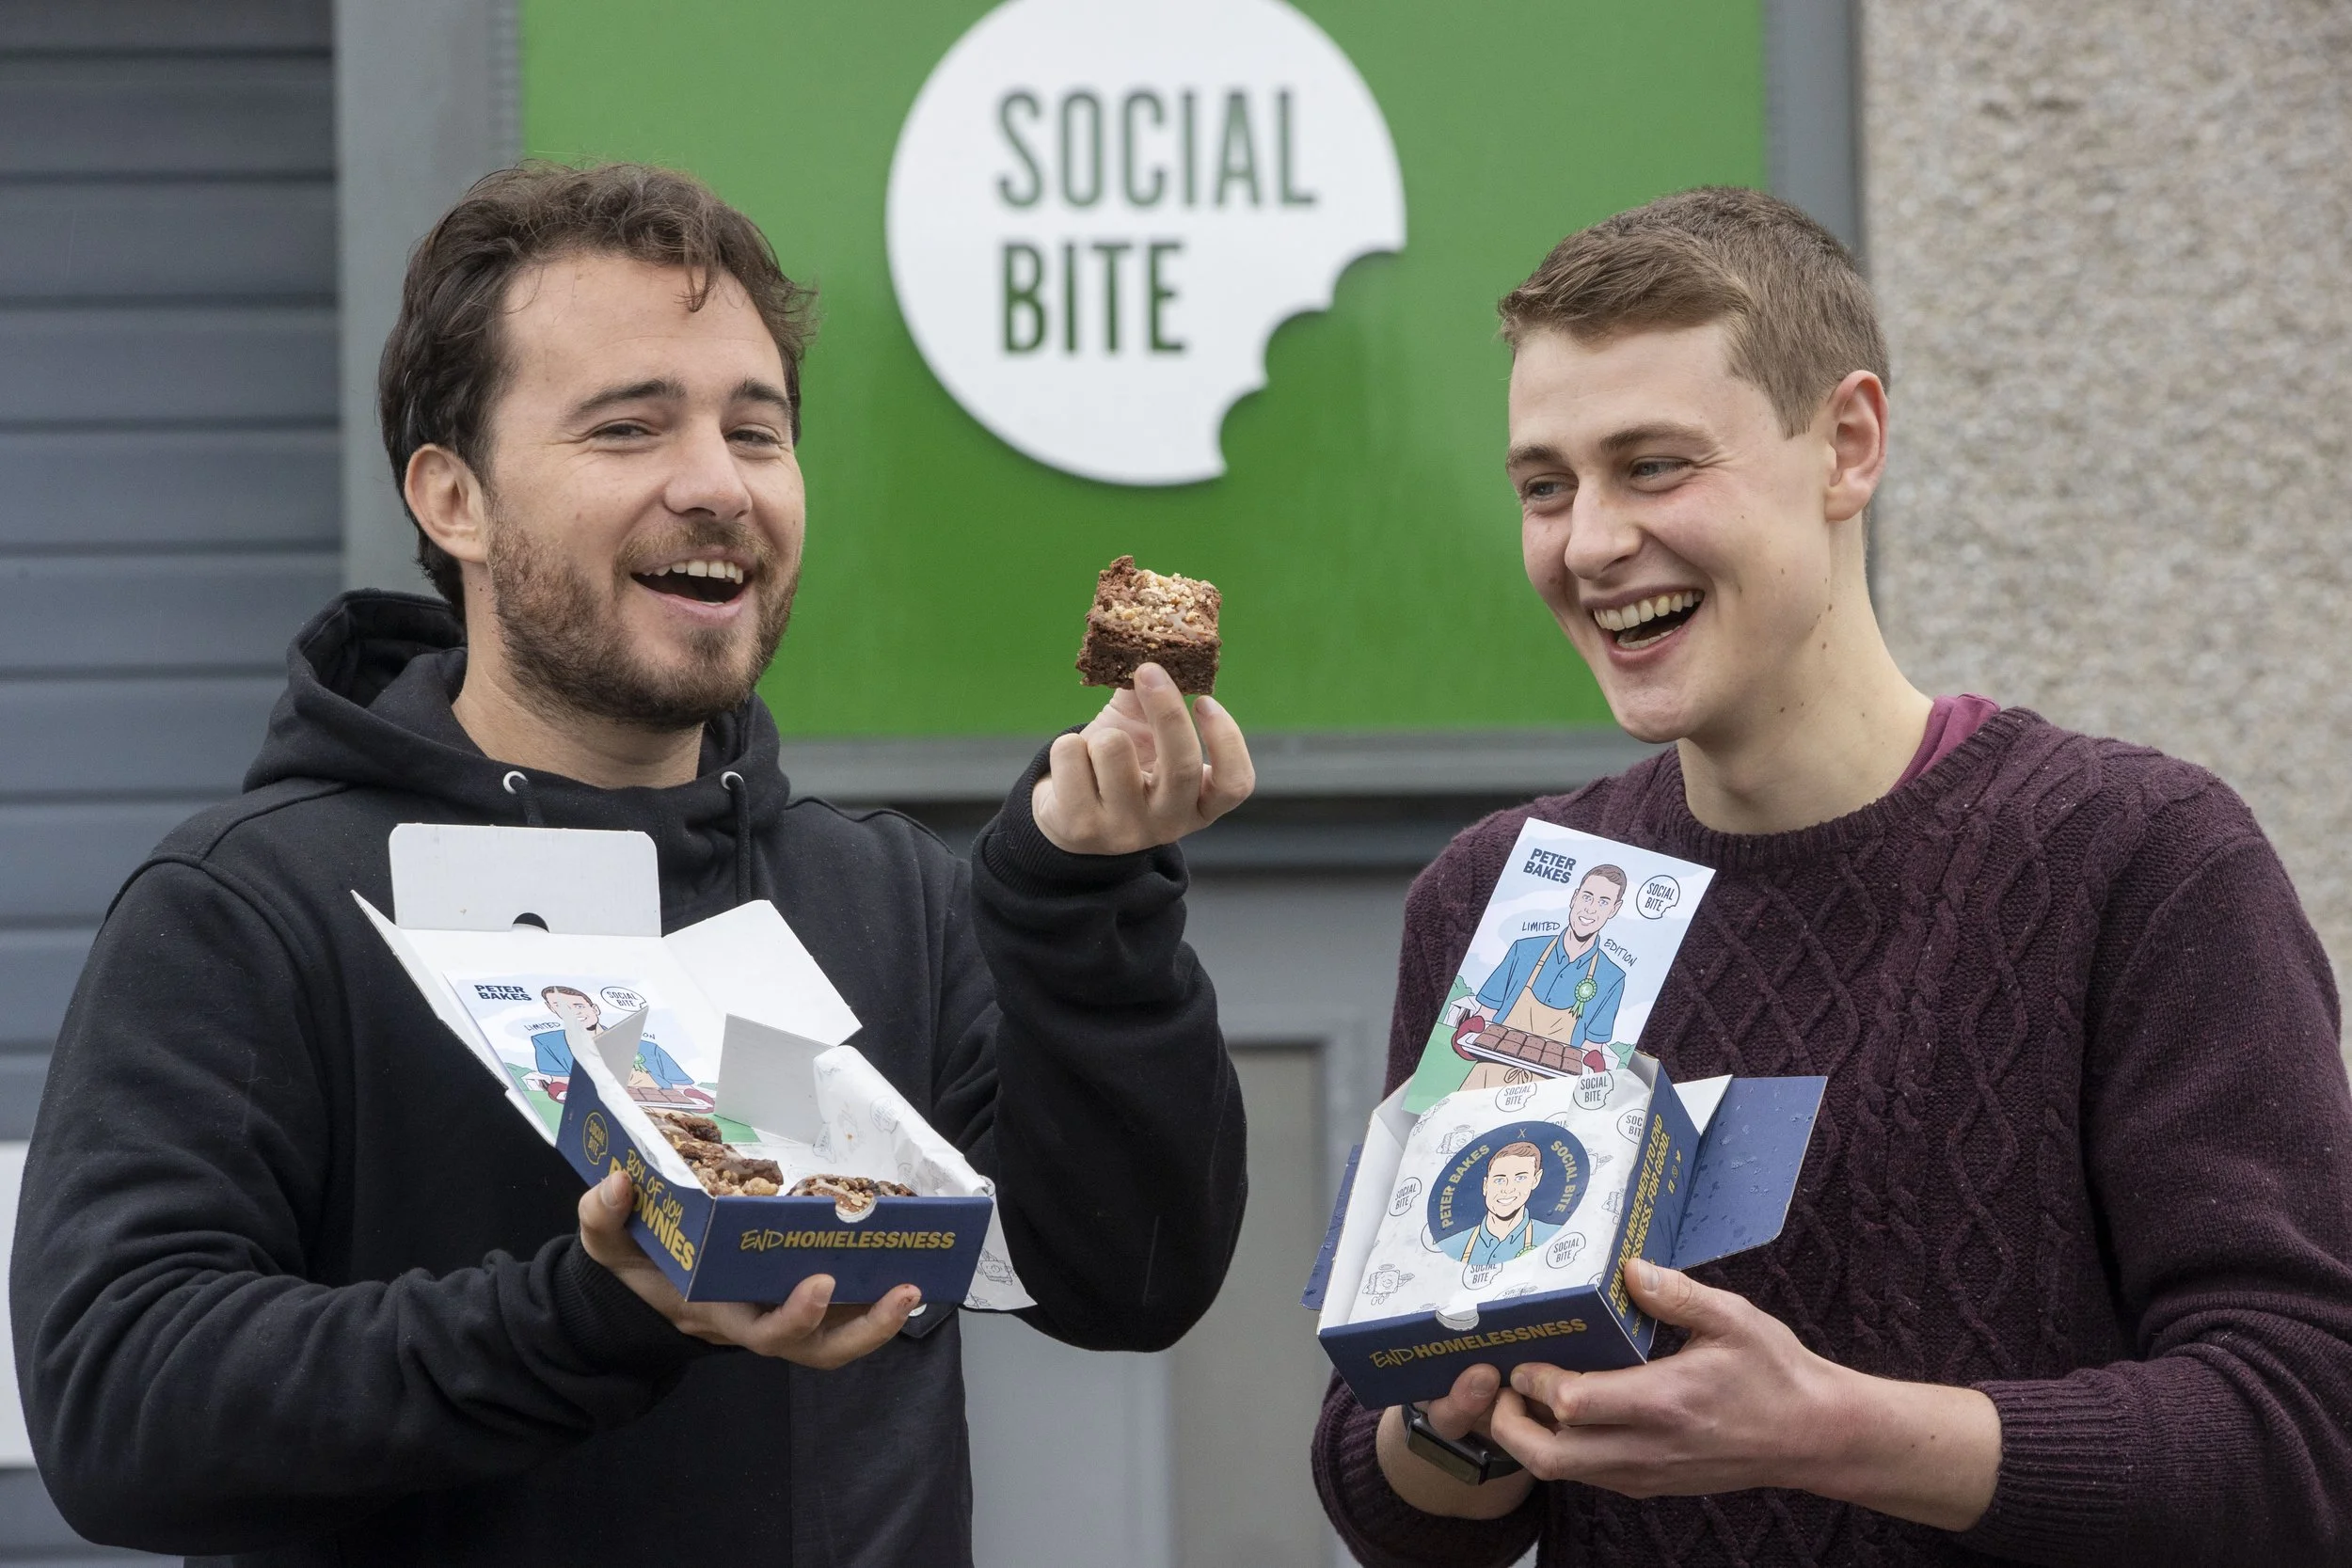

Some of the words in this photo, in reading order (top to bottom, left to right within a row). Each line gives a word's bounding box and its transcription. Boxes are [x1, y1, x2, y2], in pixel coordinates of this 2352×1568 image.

[996, 87, 1319, 209] SOCIAL
[1002, 241, 1187, 356] BITE
[1531, 847, 1577, 871] PETER
[1523, 861, 1571, 884] BAKES
[1646, 883, 1676, 900] SOCIAL
[1645, 896, 1662, 911] BITE
[1521, 921, 1561, 931] LIMITED
[1603, 939, 1638, 967] EDITION
[474, 984, 525, 994] PETER
[478, 991, 532, 1002] BAKES
[607, 991, 638, 1000] SOCIAL
[523, 1022, 561, 1032] LIMITED
[1503, 1085, 1531, 1097] SOCIAL
[1581, 1078, 1608, 1090] SOCIAL
[1505, 1096, 1522, 1106] BITE
[1584, 1091, 1601, 1102] BITE
[1629, 1126, 1643, 1137] BIT
[1448, 1144, 1490, 1184] BAKES
[1550, 1140, 1579, 1183] SOCIAL
[626, 1148, 646, 1182] BOX
[646, 1176, 665, 1202] OF
[662, 1192, 684, 1228] JOY
[1395, 1183, 1416, 1201] SOCIAL
[1647, 1171, 1661, 1205] FOR
[1395, 1196, 1409, 1210] BITE
[1439, 1185, 1455, 1228] PETER
[1554, 1184, 1577, 1213] BITE
[608, 1156, 695, 1271] BOWNIES
[1609, 1268, 1624, 1307] JOIN
[1626, 1160, 1651, 1242] MOVEMENT
[1646, 1143, 1656, 1165] TO
[1651, 1114, 1663, 1147] END
[1553, 1240, 1580, 1254] SOCIAL
[1555, 1251, 1572, 1262] BITE
[1472, 1273, 1489, 1284] BITE
